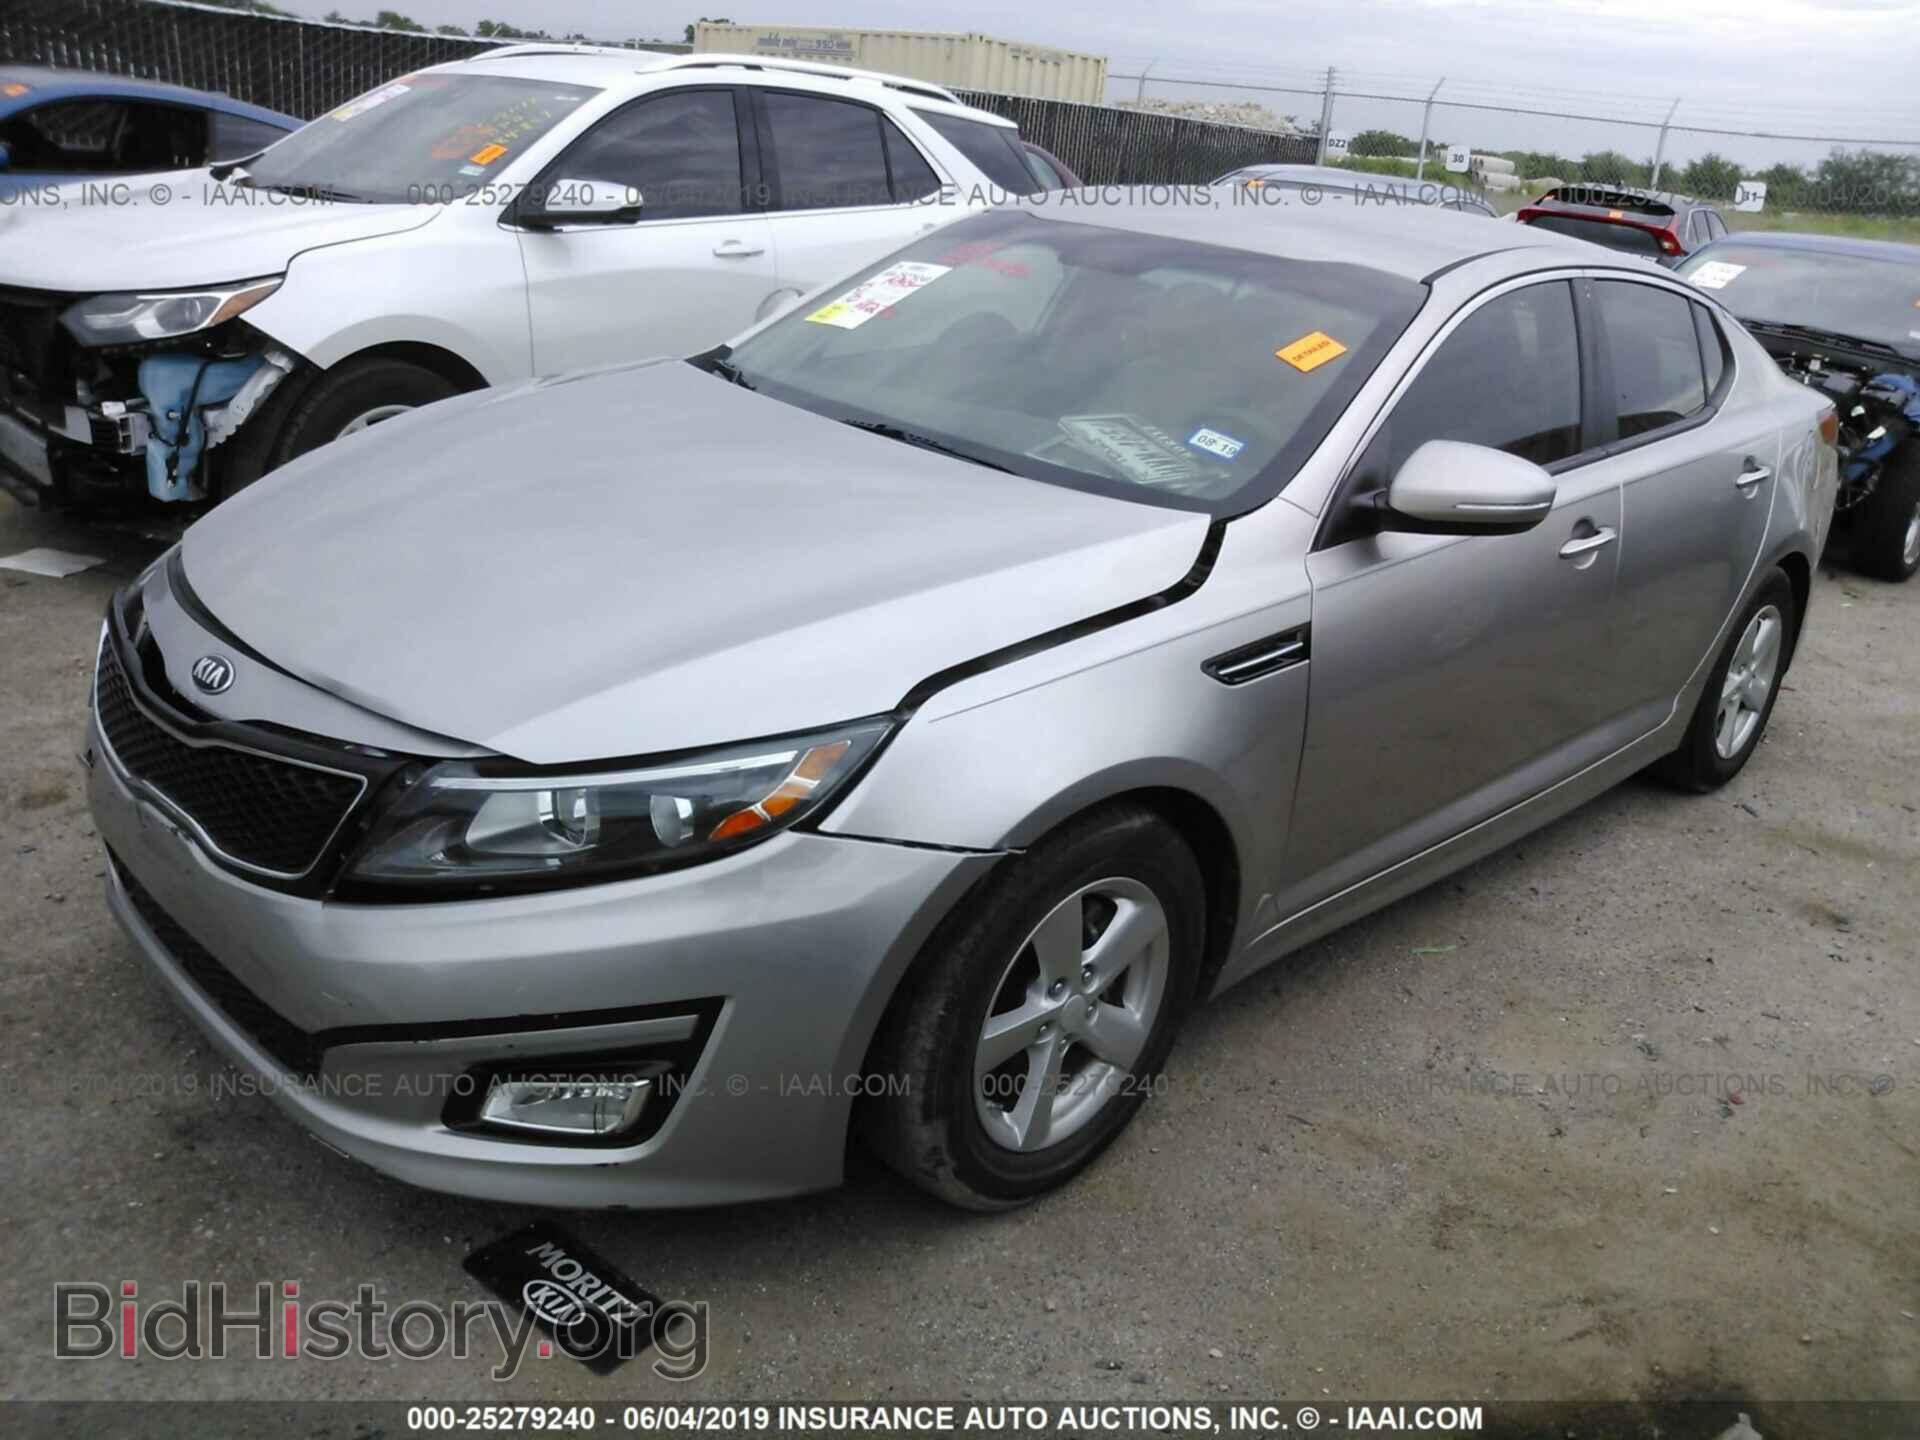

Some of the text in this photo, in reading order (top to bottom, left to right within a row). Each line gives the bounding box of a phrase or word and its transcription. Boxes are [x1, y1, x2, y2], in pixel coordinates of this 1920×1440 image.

[193, 657, 225, 688] KIA
[525, 1241, 649, 1327] MORITZ
[530, 1285, 578, 1322] KIA
